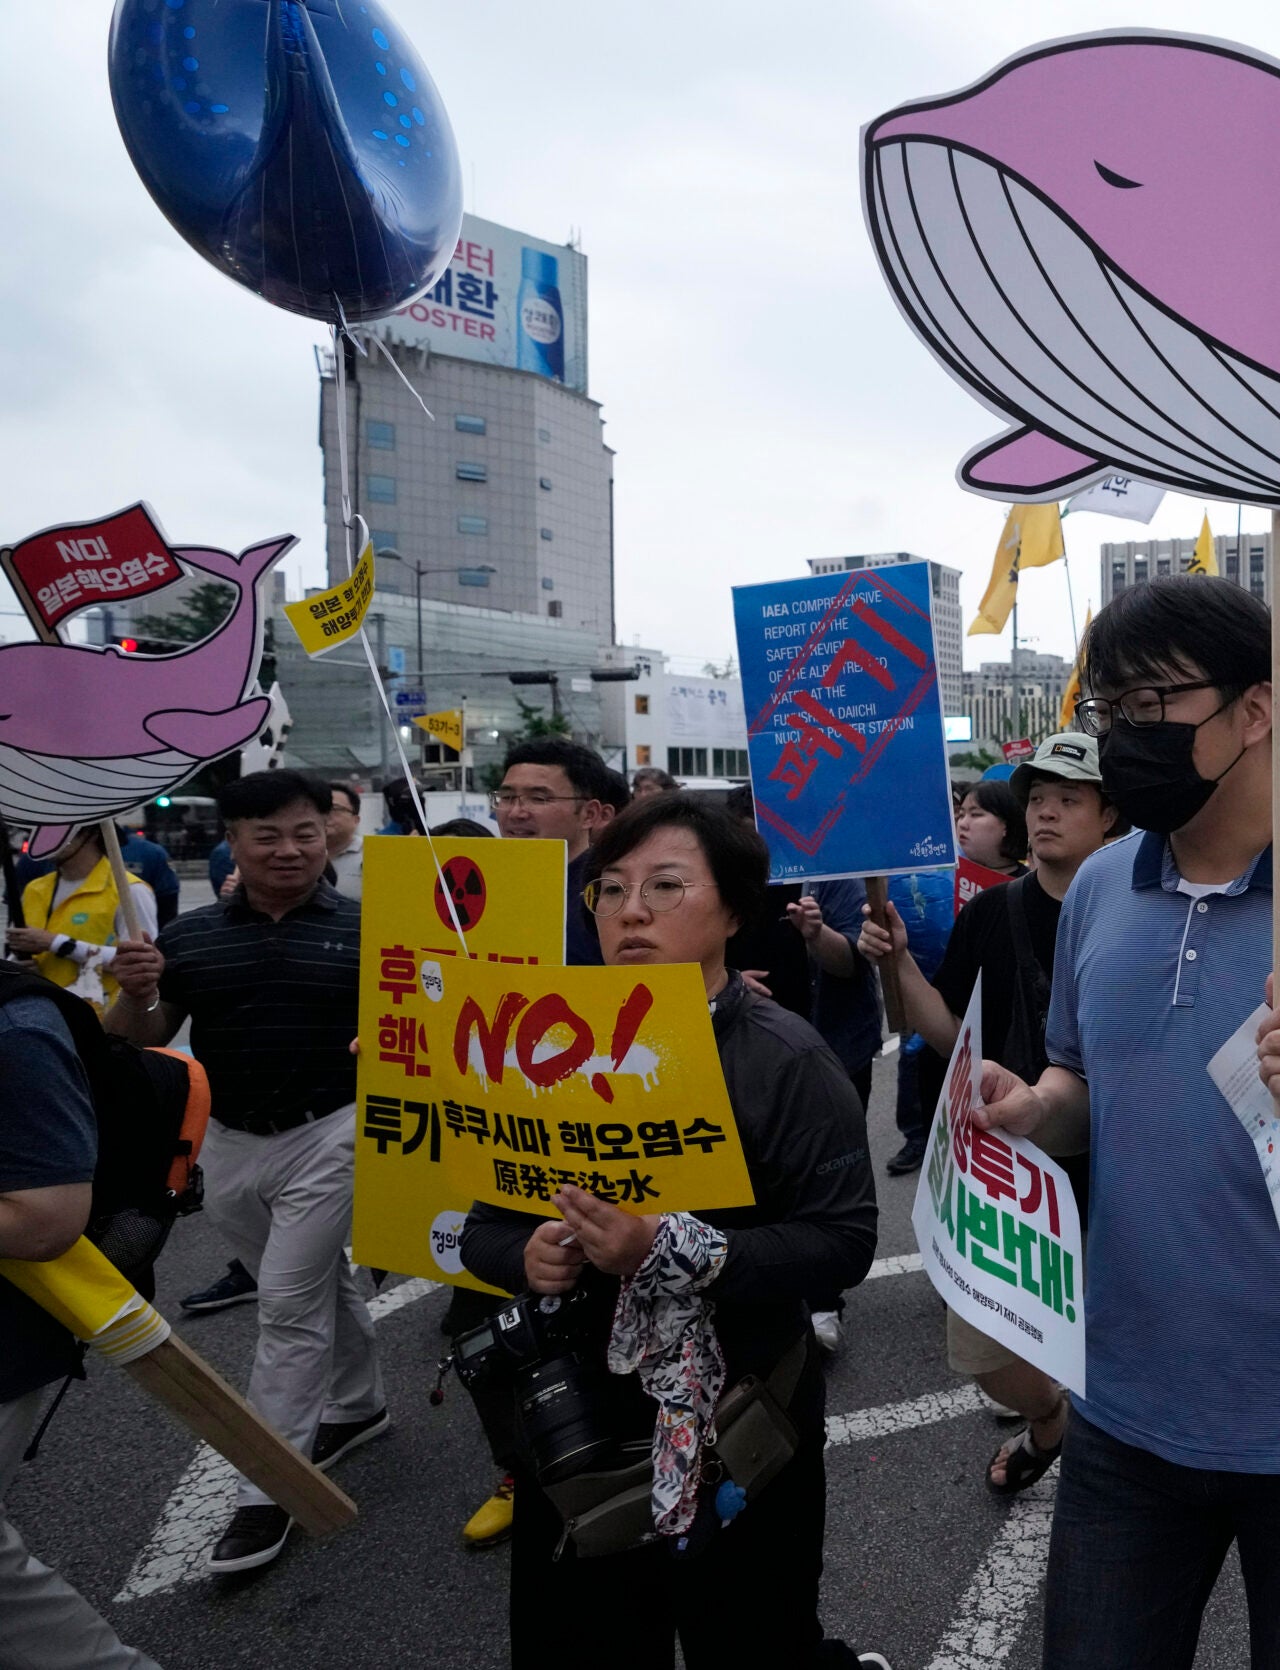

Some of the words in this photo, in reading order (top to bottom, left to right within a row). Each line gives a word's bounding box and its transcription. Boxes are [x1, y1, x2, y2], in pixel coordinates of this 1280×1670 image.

[55, 536, 112, 563] NO!
[309, 595, 343, 620] 일본
[762, 603, 790, 618] IAEA
[792, 589, 882, 614] COMPREHENSIVE
[764, 622, 807, 640] REPORT
[810, 621, 827, 636] ON
[829, 617, 849, 632] THE
[766, 645, 805, 662] SAFETY
[769, 670, 783, 683] OF
[809, 664, 832, 678] ALP
[811, 687, 823, 700] AT
[824, 684, 847, 698] THE
[838, 703, 877, 720] DAIICHI
[827, 723, 866, 738] POER
[869, 716, 915, 734] STATION
[785, 865, 805, 874] IAEA
[959, 877, 984, 901] 일
[453, 983, 654, 1104] NO!
[364, 1094, 441, 1163] 투기
[443, 1100, 551, 1157] 후쿠시마
[558, 1117, 727, 1162] 핵오염수
